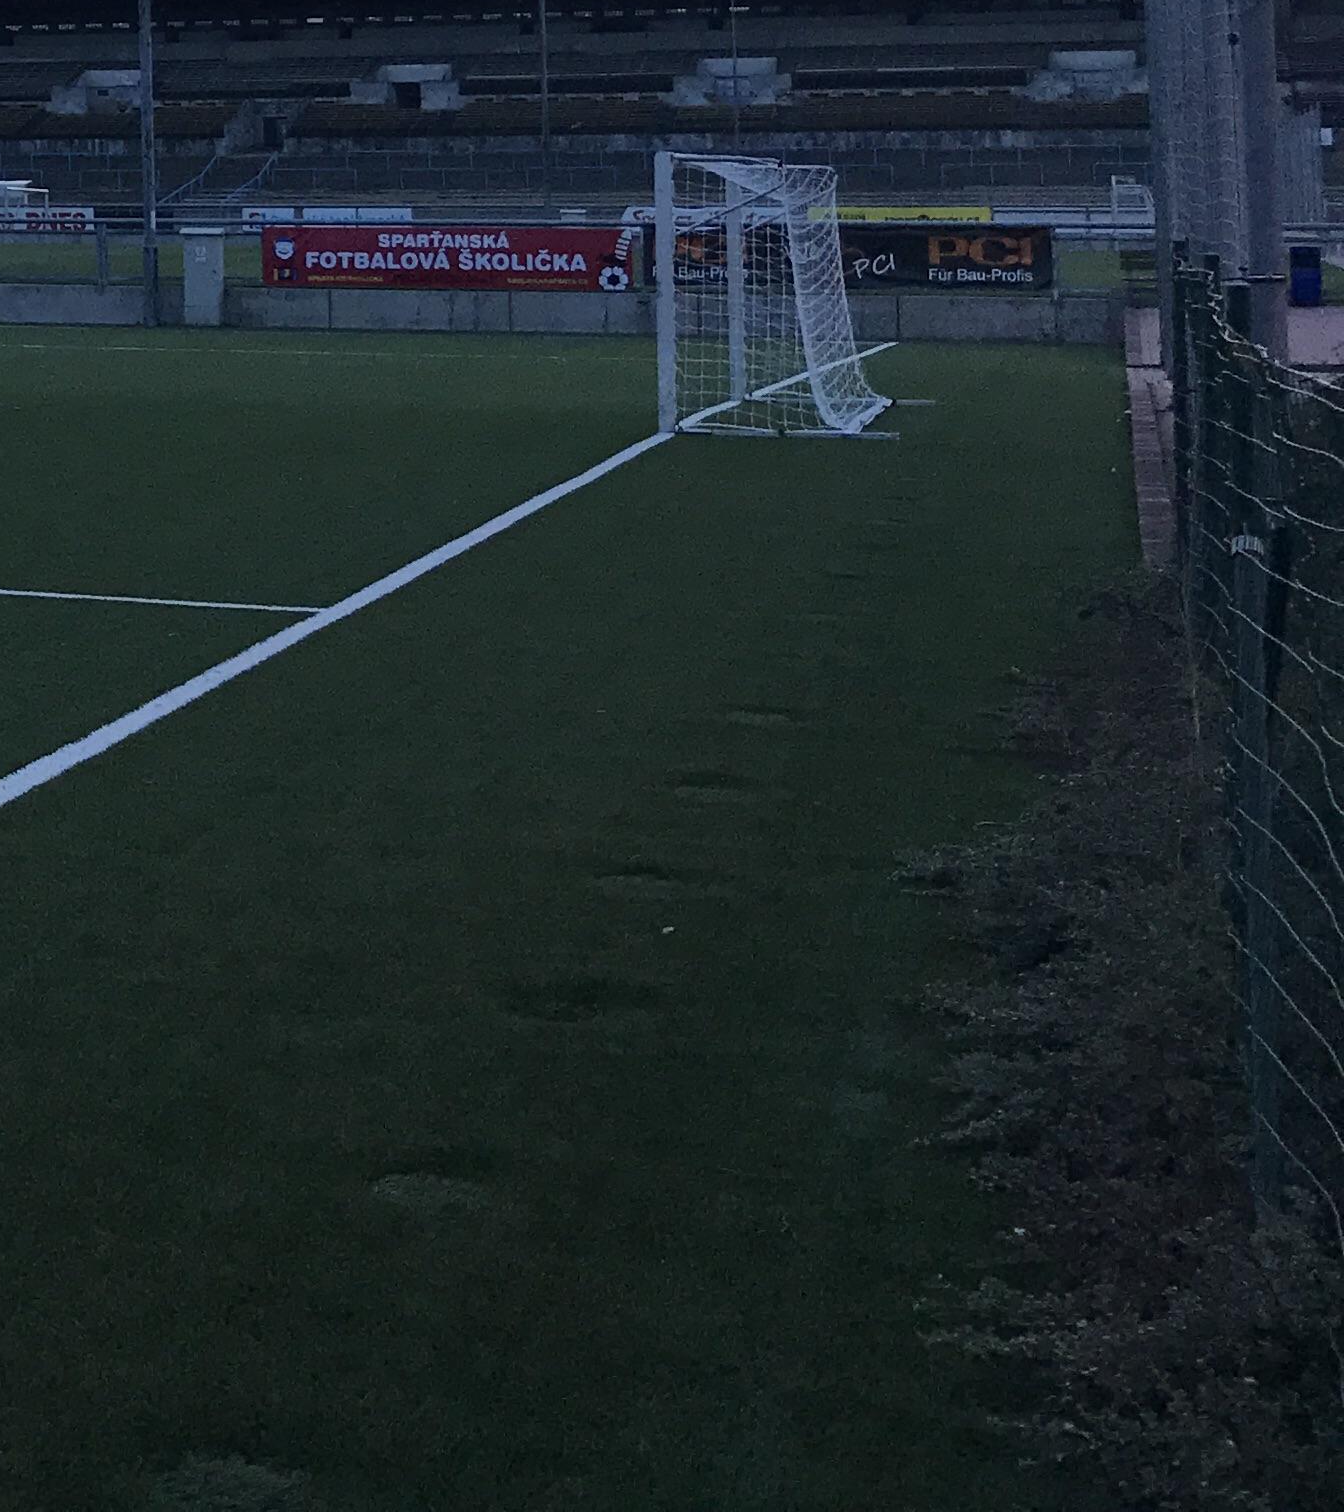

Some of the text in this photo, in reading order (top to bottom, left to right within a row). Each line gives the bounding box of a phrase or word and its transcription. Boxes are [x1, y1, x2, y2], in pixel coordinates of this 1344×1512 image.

[377, 230, 510, 249] SPARŤANSKÁ
[927, 236, 1033, 266] PCI
[305, 247, 588, 272] FOTBALOVÁ ŠKOLIČKA
[852, 253, 896, 280] PCI
[928, 268, 1034, 283] Für Bau-Profis
